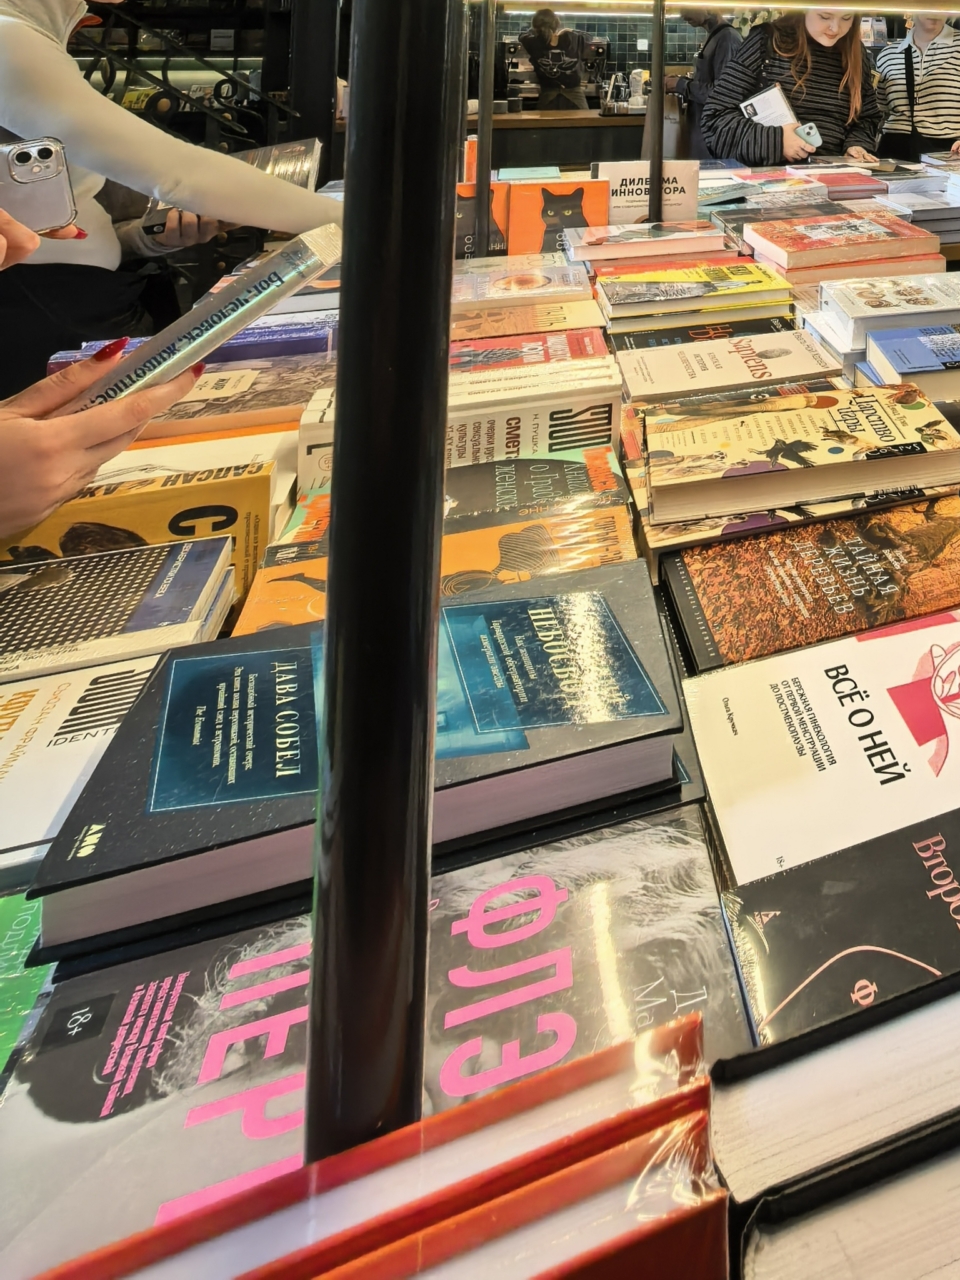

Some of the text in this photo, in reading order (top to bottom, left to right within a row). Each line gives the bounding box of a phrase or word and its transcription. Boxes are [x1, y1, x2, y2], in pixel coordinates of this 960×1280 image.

[611, 187, 696, 197] ИННОВОРА
[620, 177, 678, 188] ДИЛЕМА
[728, 338, 772, 380] Sapiens
[485, 419, 495, 444] очерки
[506, 417, 521, 459] смет
[531, 423, 540, 455] ПУШКА
[837, 406, 866, 434] игры
[850, 394, 896, 443] Царство
[457, 423, 468, 459] культуры
[471, 421, 482, 464] сексуально
[162, 461, 264, 488] САПСАН
[495, 464, 518, 509] женско
[792, 541, 854, 614] ДЕРЕВЬЕВ
[823, 546, 869, 597] ЖИЗНЬ
[844, 536, 898, 595] ТАЙНАЯ
[528, 606, 582, 706] НЕБОСВОД
[505, 655, 528, 703] обсерватории
[192, 716, 205, 746] Economist
[244, 709, 257, 749] исторический
[271, 661, 301, 778] ДАВА СОБЕЛ
[769, 683, 807, 757] ДО ПОСТМЕНОПАУЗЫ
[781, 680, 827, 772] ОТ ПЕРВОЙ МЕНСТРУАЦИИ
[791, 677, 837, 766] БЕРЕЖНАЯ ГИНЕКОЛОГИЯ
[824, 664, 911, 786] ВСЁ О НЕЙ
[440, 875, 570, 1096] ФЛЭ
[67, 1006, 92, 1037] 18+
[122, 988, 143, 1027] Великой
[102, 1023, 129, 1076] депрессией
[125, 1015, 145, 1046] между
[111, 1043, 138, 1085] Великой
[100, 1080, 121, 1118] войной
